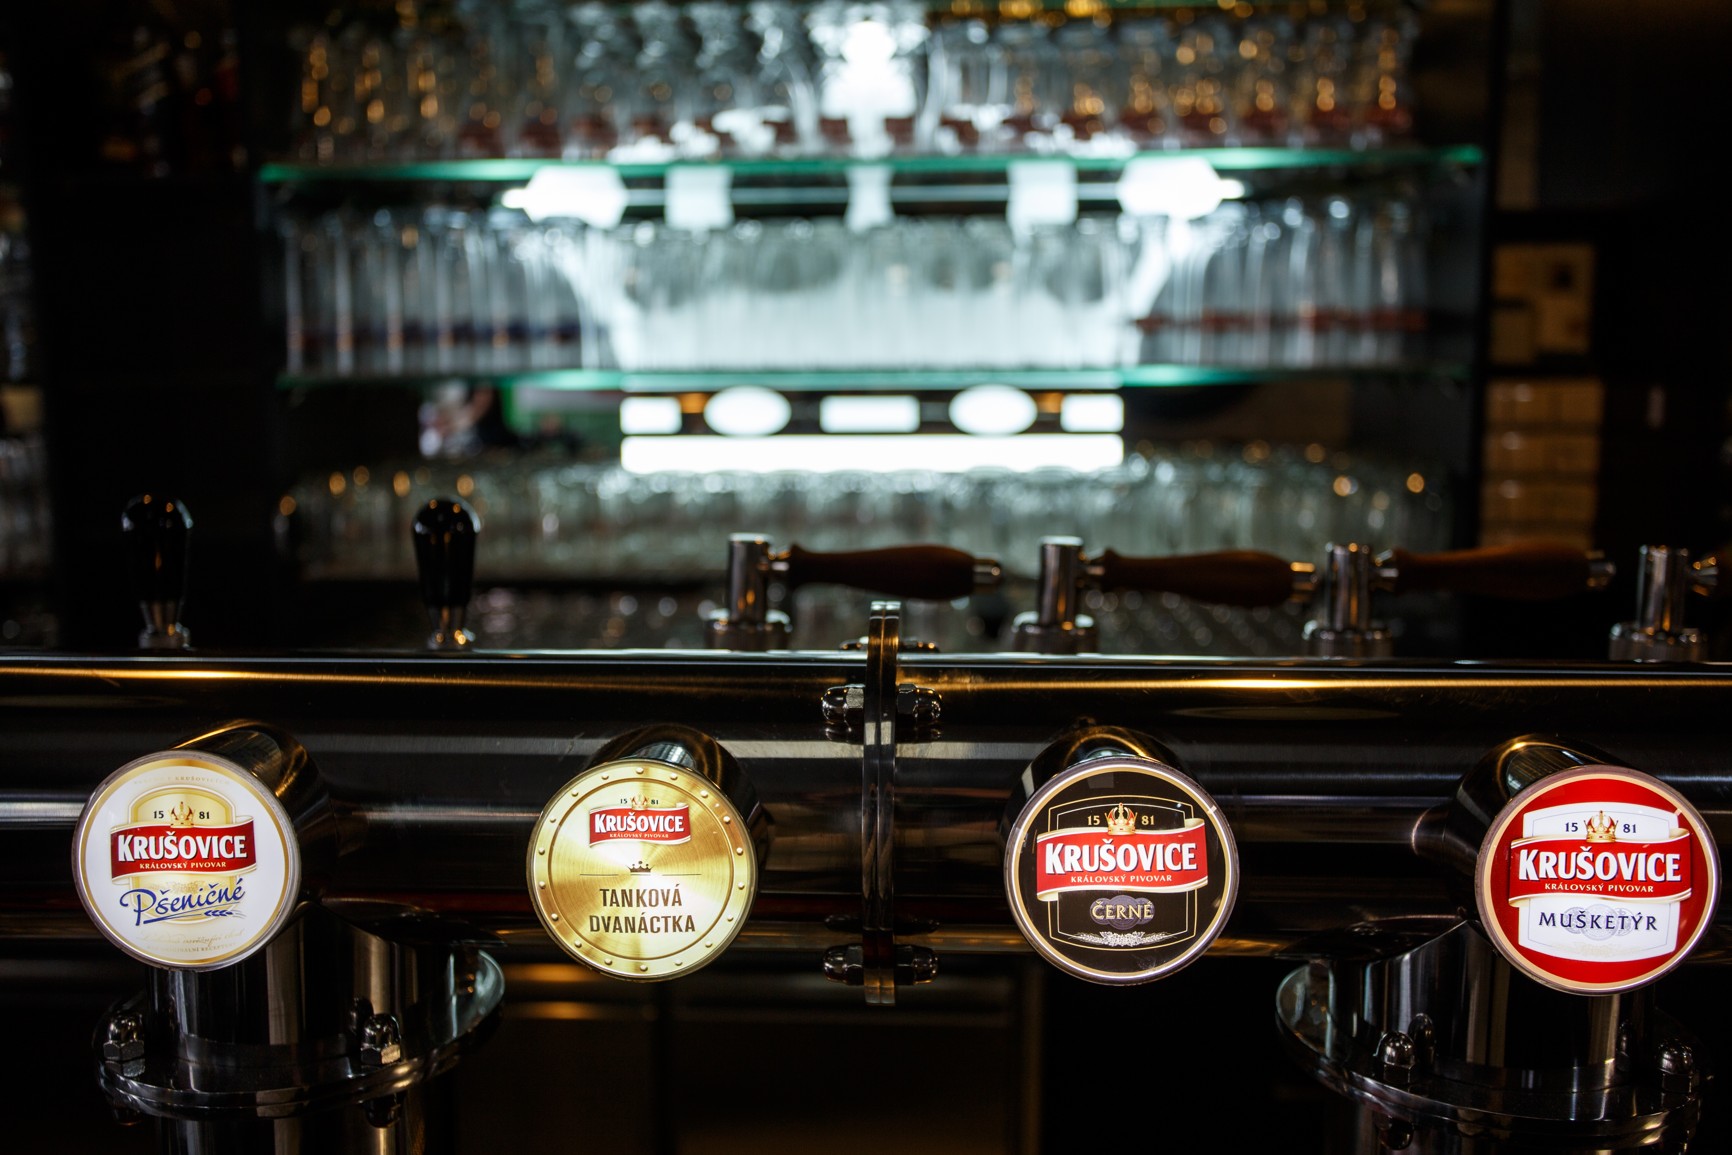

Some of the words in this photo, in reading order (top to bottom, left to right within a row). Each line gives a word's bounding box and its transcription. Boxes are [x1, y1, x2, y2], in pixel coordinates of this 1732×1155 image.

[153, 810, 164, 819] 15
[199, 811, 210, 820] 81
[594, 812, 684, 833] KRUŠOVICE
[1087, 815, 1100, 826] 15
[1141, 815, 1155, 826] 81
[1565, 822, 1578, 832] 15
[1623, 823, 1637, 834] 81
[118, 831, 248, 862] KRUŠOVICE
[139, 860, 188, 869] KRÁLOVSKÝ
[1045, 839, 1198, 875] KRUŠOVICE
[1518, 846, 1682, 882] KRUŠOVICE
[1070, 874, 1127, 883] KRÁLOVSKÝ
[1130, 874, 1172, 882] PIVOVAR
[1544, 882, 1604, 892] KRÁLOVSKÝ
[1608, 884, 1654, 893] PIVOVAR
[119, 878, 245, 926] Pšeničné
[600, 884, 682, 907] TANKOVÁ
[1091, 900, 1154, 920] ČERNÉ
[590, 912, 695, 934] DVANÁCTKA
[1538, 911, 1658, 931] MUŠKETÝR
